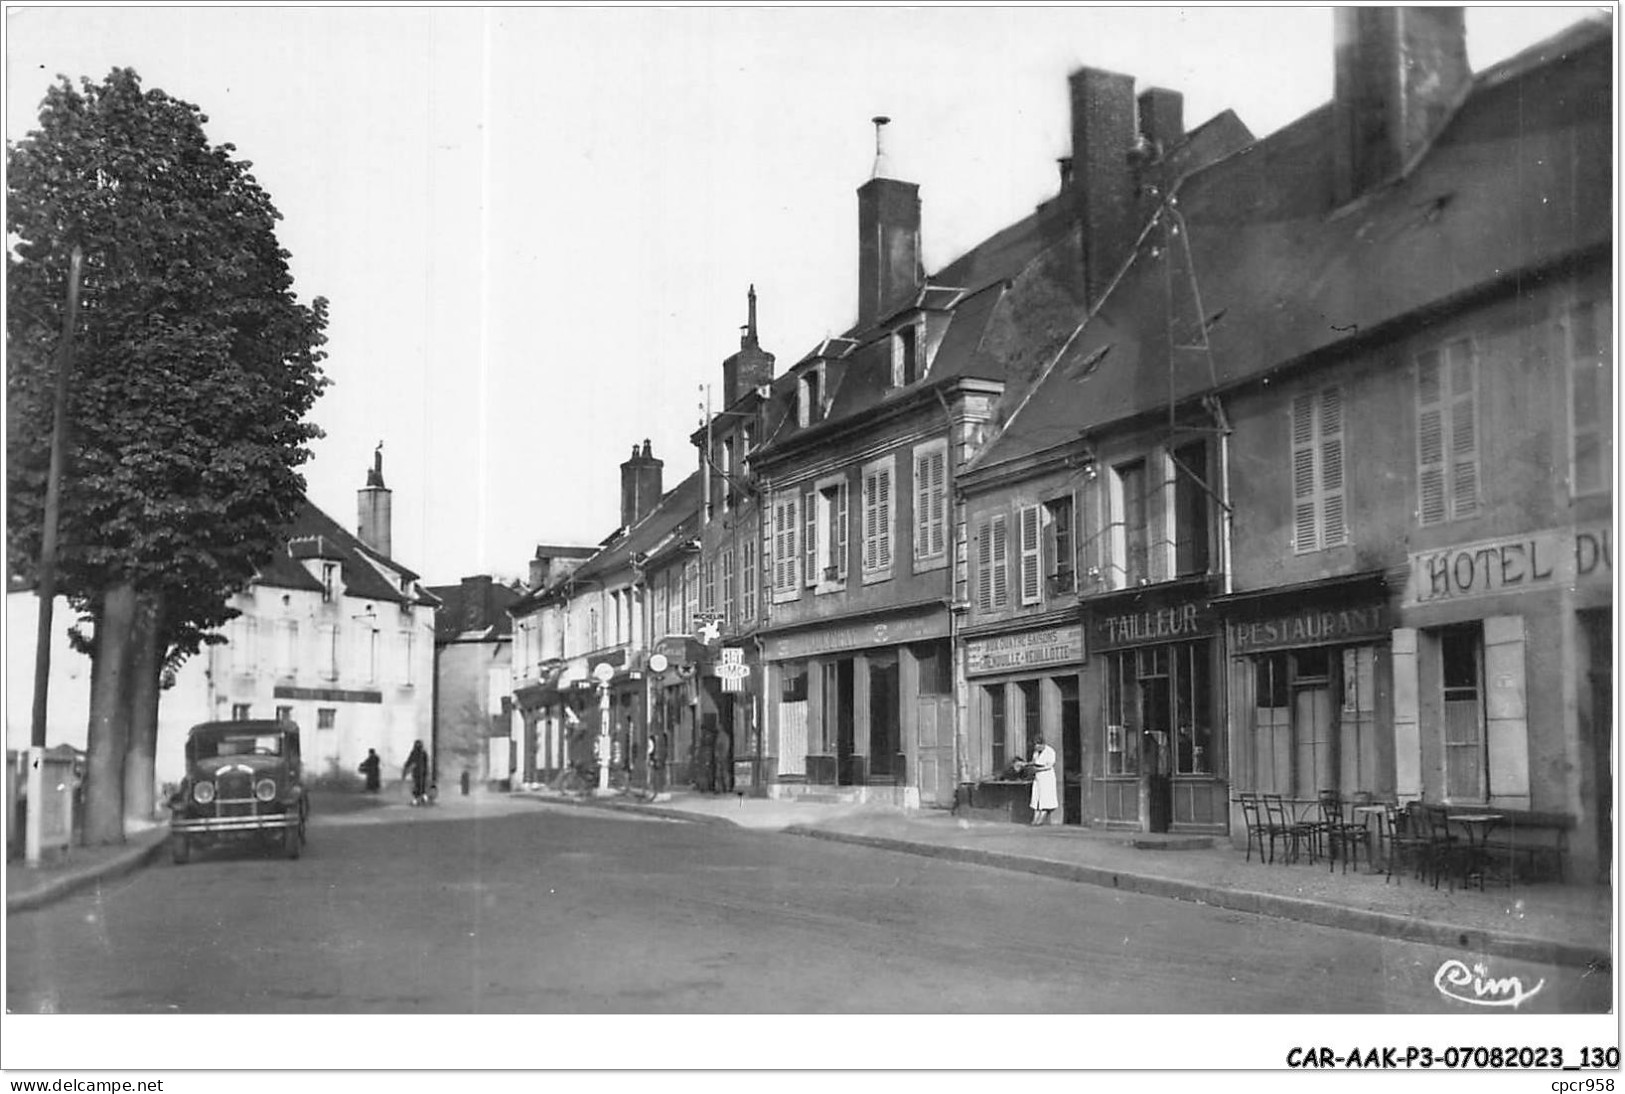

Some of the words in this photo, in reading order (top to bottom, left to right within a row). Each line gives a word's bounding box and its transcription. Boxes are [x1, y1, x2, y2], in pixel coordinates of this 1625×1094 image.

[1426, 542, 1554, 599] HOTEL
[1106, 603, 1198, 643] TAILLEUR
[1237, 606, 1382, 647] RESTAURANT
